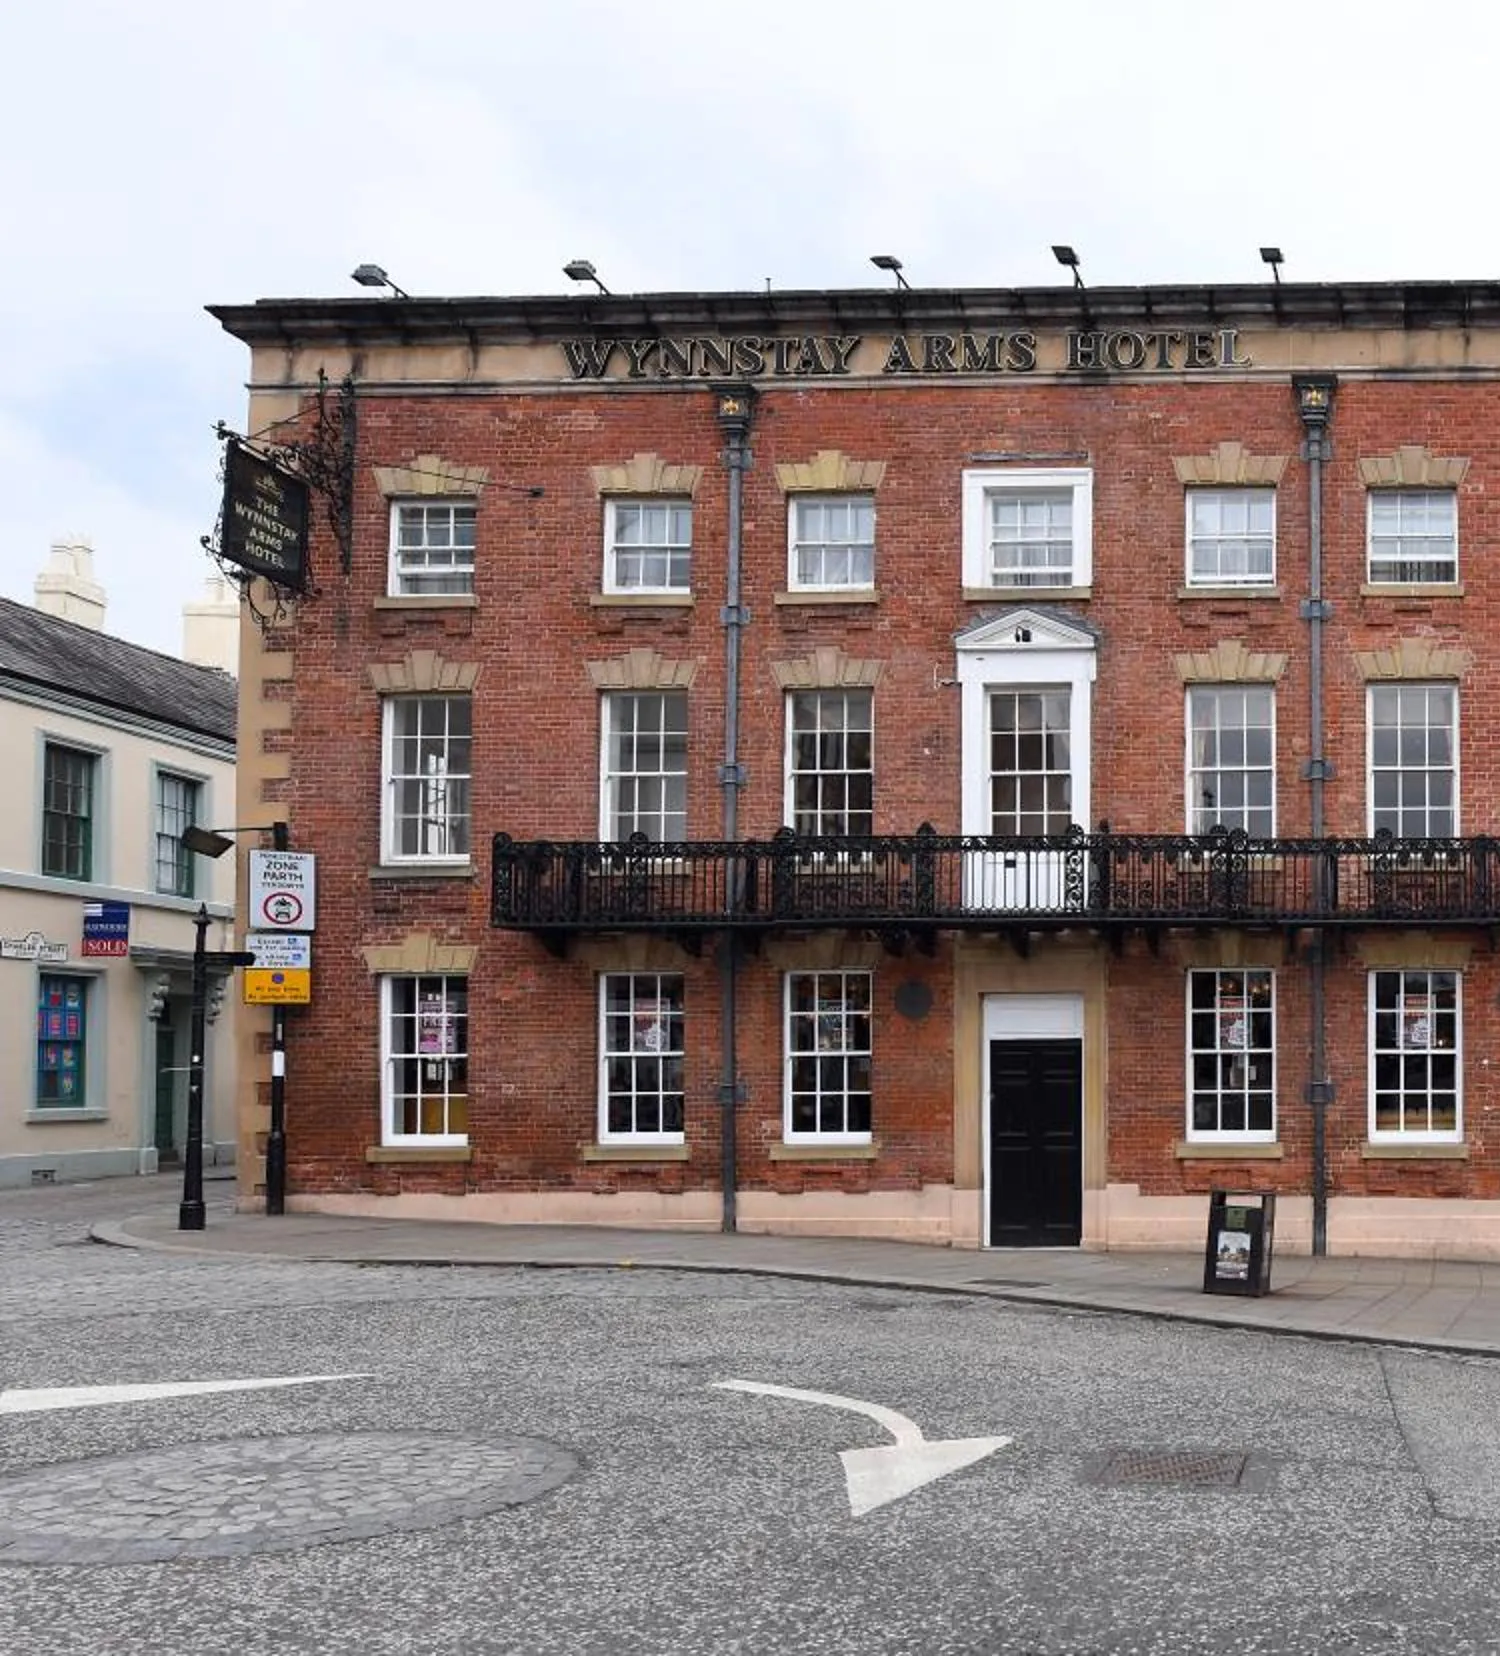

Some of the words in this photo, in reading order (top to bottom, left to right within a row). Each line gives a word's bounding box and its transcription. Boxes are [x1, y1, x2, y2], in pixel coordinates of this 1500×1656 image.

[560, 335, 862, 378] WYNNSTAY
[881, 331, 1038, 373] ARMS
[1065, 328, 1253, 369] HOTEL
[256, 497, 279, 517] THE
[234, 501, 298, 541] WYNNSTAY
[249, 527, 283, 550] ARMS
[244, 540, 285, 569] HOTEL
[265, 860, 299, 870] ZONE
[88, 941, 128, 952] SOLD
